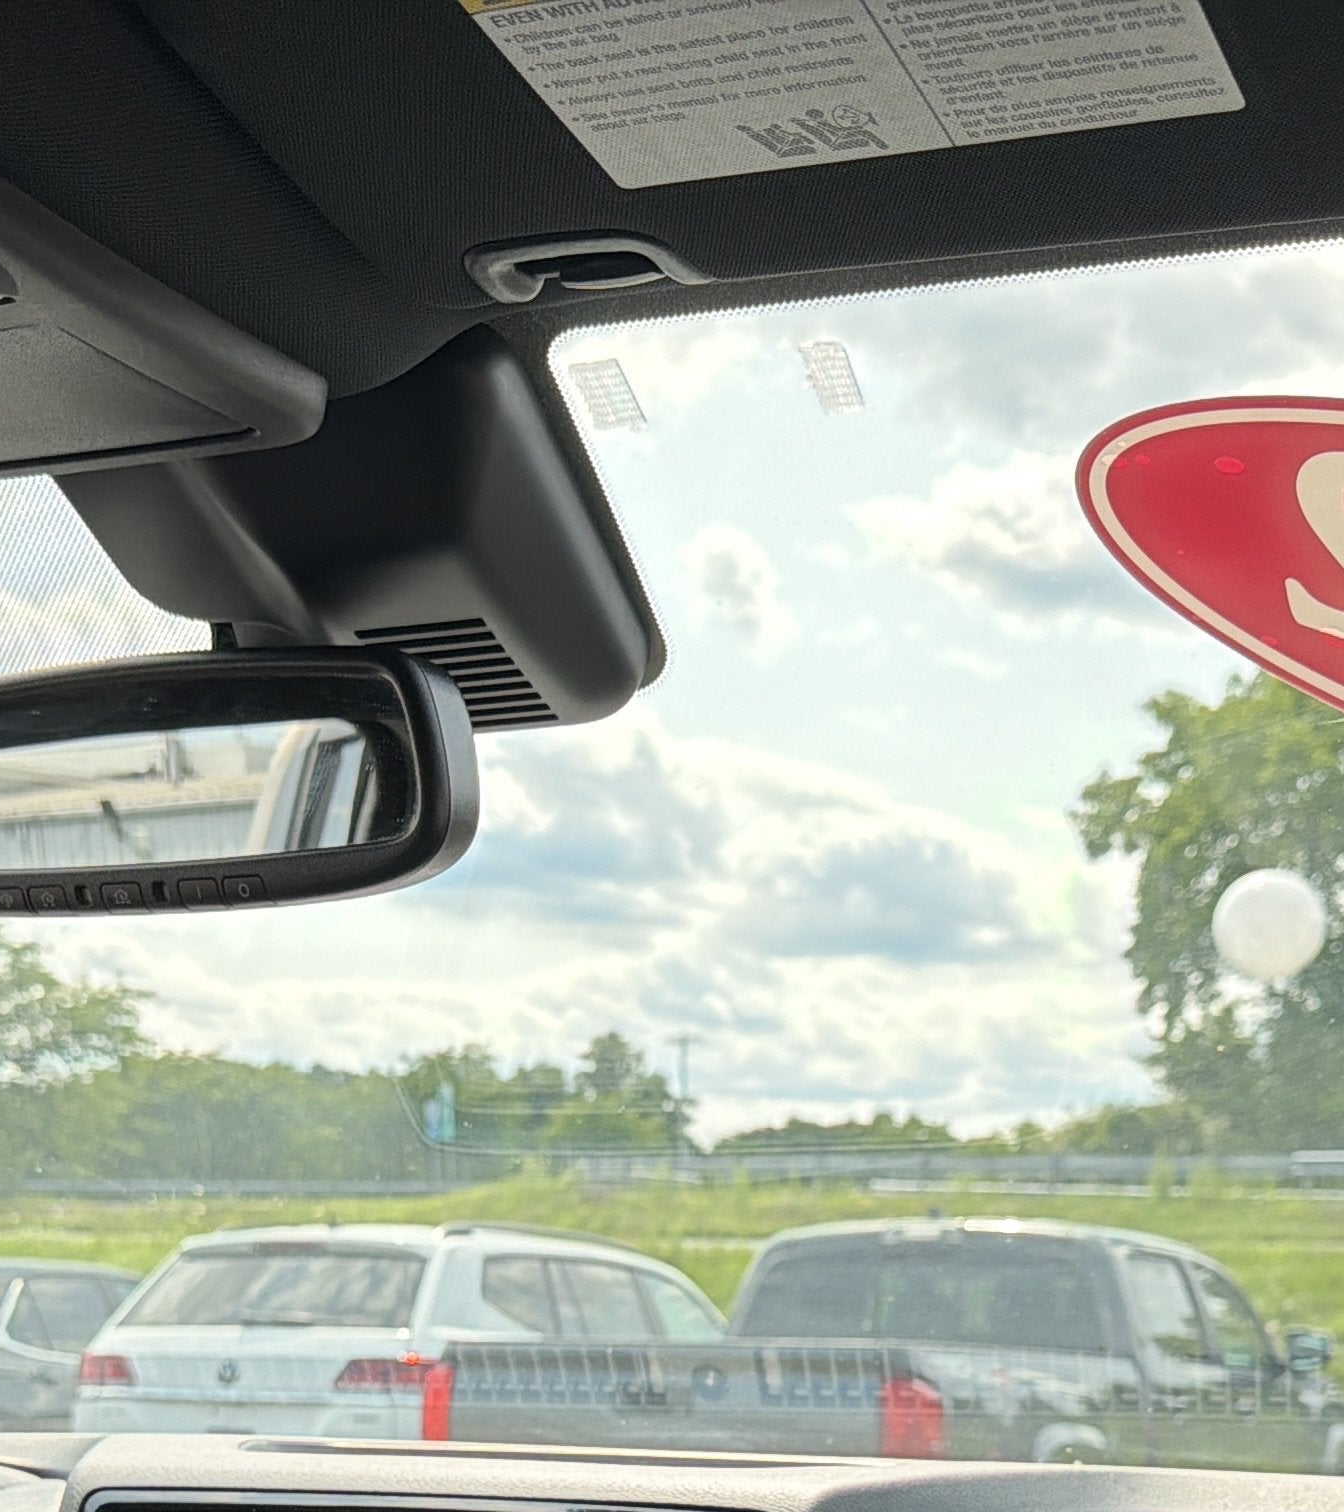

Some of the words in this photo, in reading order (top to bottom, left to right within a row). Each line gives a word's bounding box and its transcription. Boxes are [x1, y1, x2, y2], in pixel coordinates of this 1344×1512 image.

[489, 11, 544, 28] EVEN
[549, 2, 601, 19] WITH
[513, 28, 573, 45] Children
[575, 22, 601, 34] can
[536, 61, 564, 73] The
[568, 54, 602, 67] back
[679, 35, 724, 48] safest
[727, 31, 766, 44] place
[793, 15, 855, 32] children
[523, 45, 540, 56] by
[543, 40, 566, 52] the
[551, 74, 593, 89] Never
[830, 33, 868, 47] front
